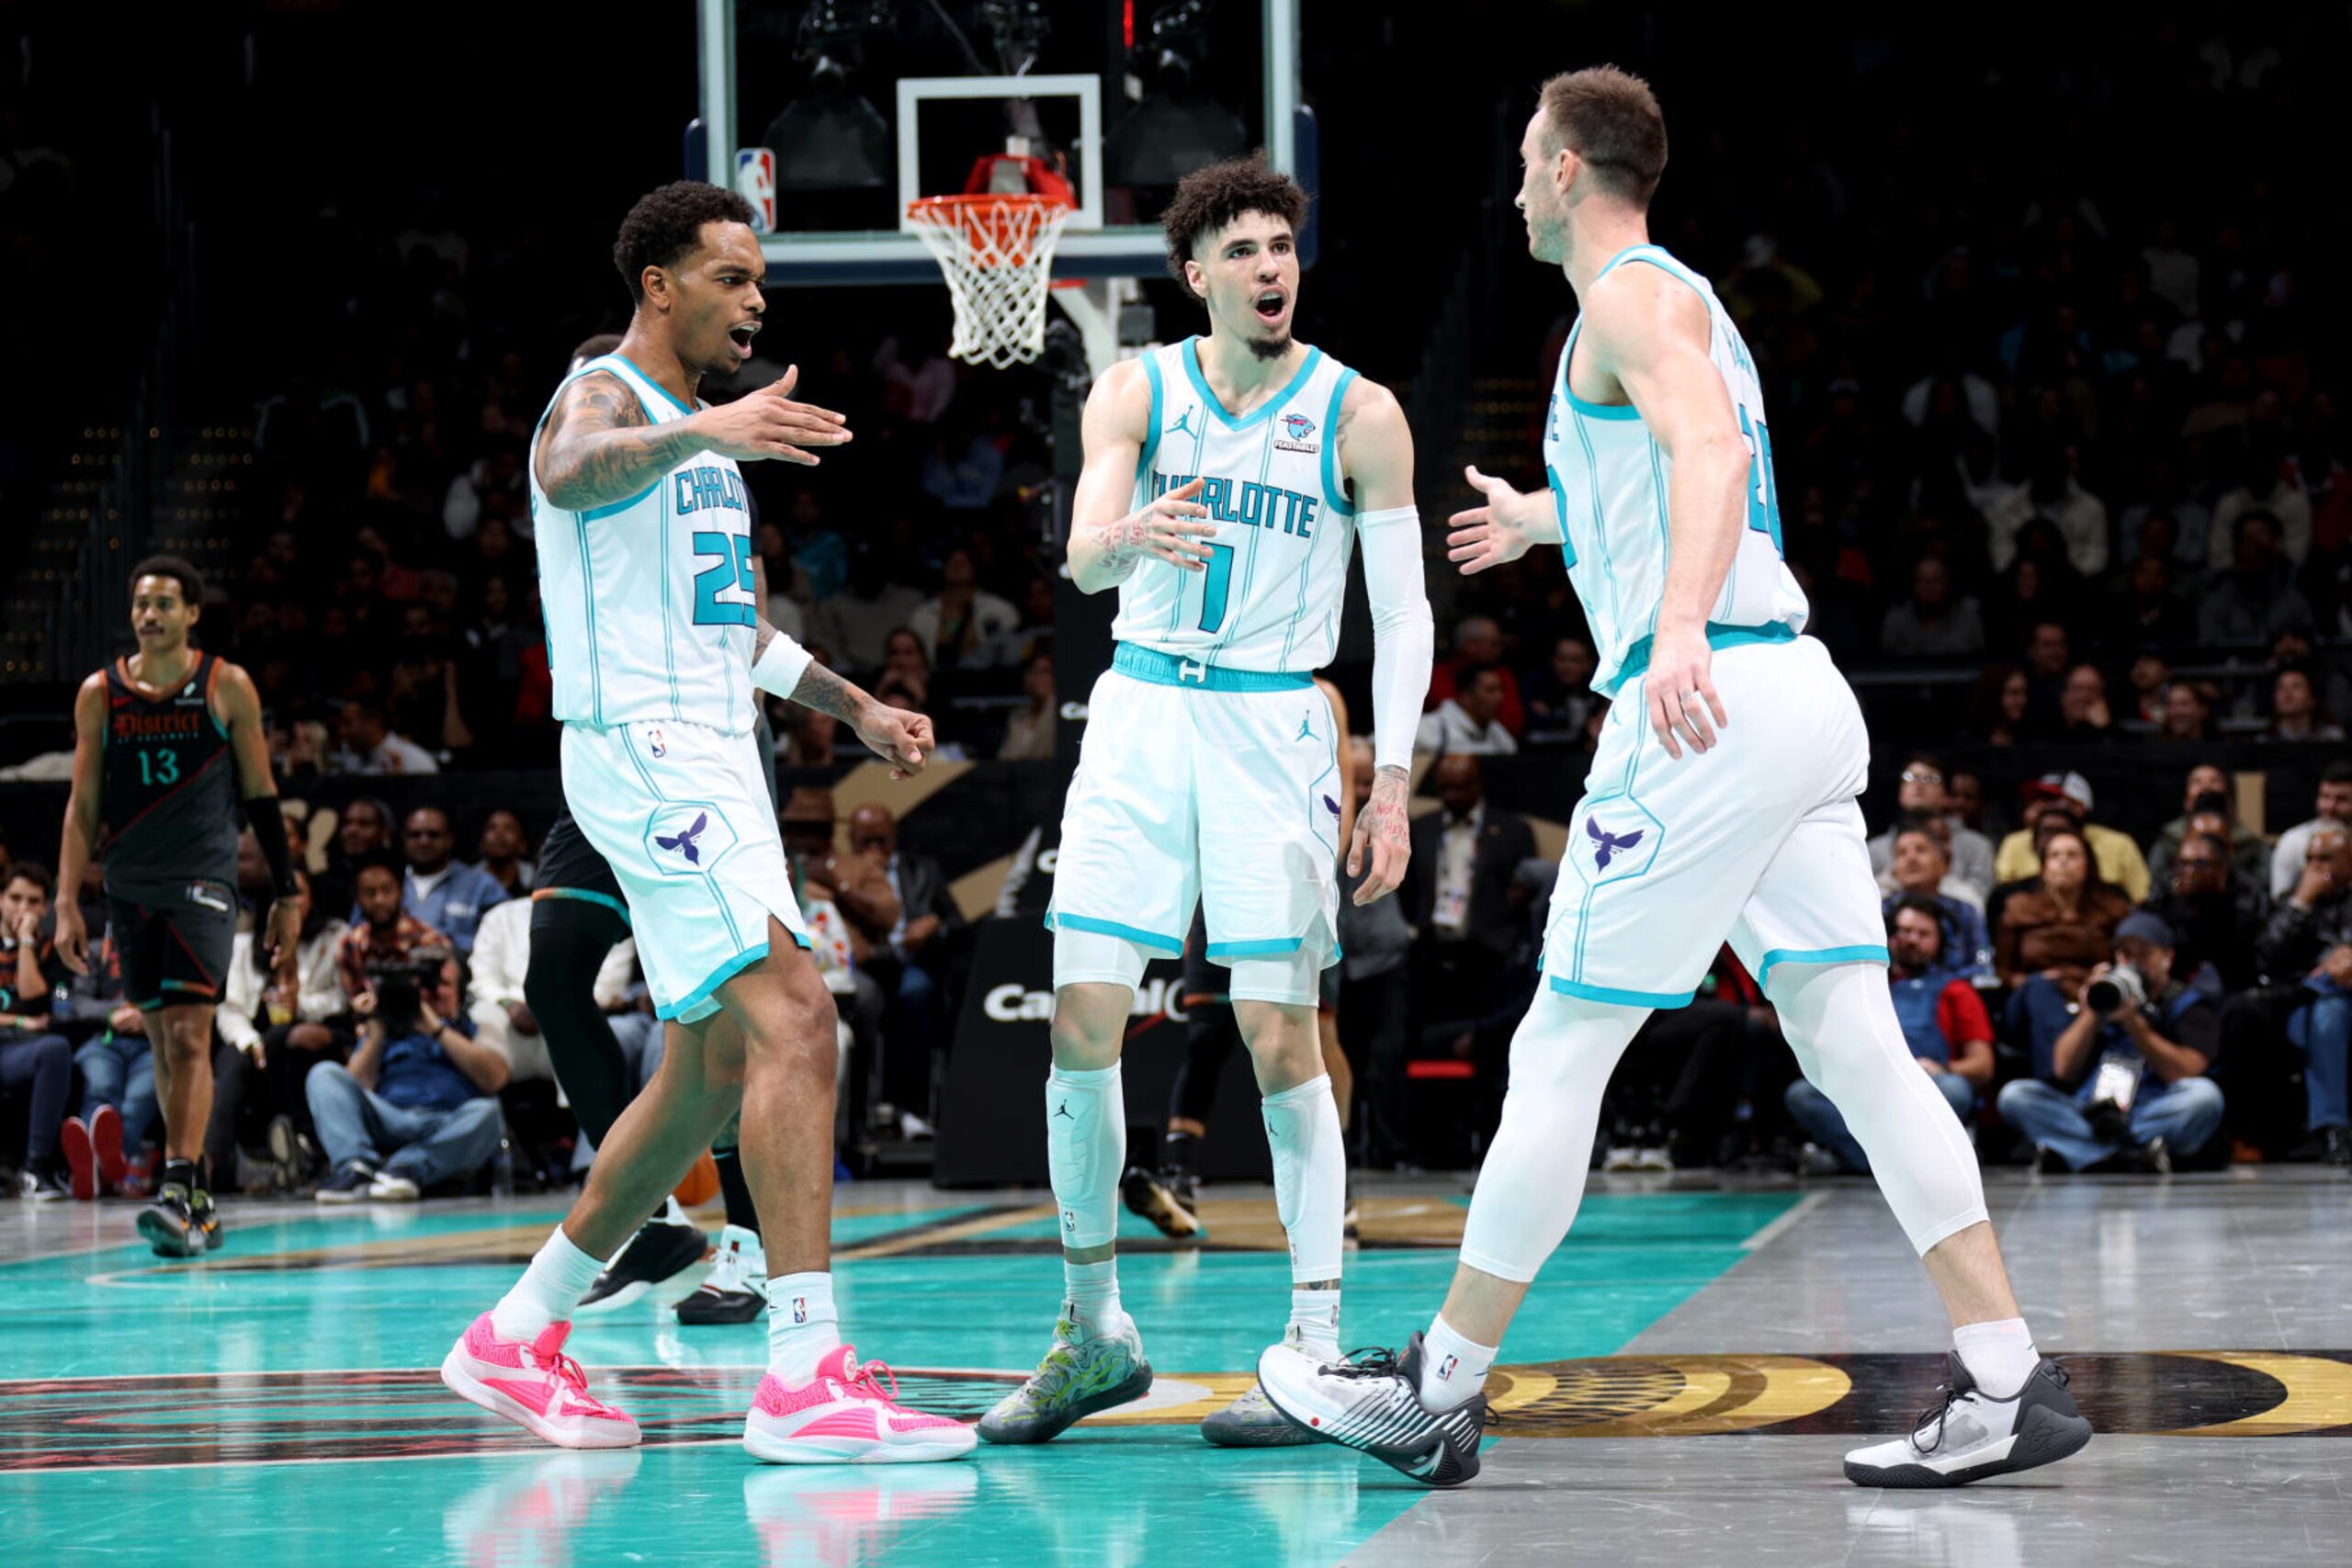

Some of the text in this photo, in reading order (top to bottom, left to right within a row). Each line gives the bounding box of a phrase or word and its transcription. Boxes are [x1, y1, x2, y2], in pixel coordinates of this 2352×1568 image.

[693, 531, 757, 629] 25
[1198, 540, 1235, 635] 1
[137, 749, 180, 785] 13
